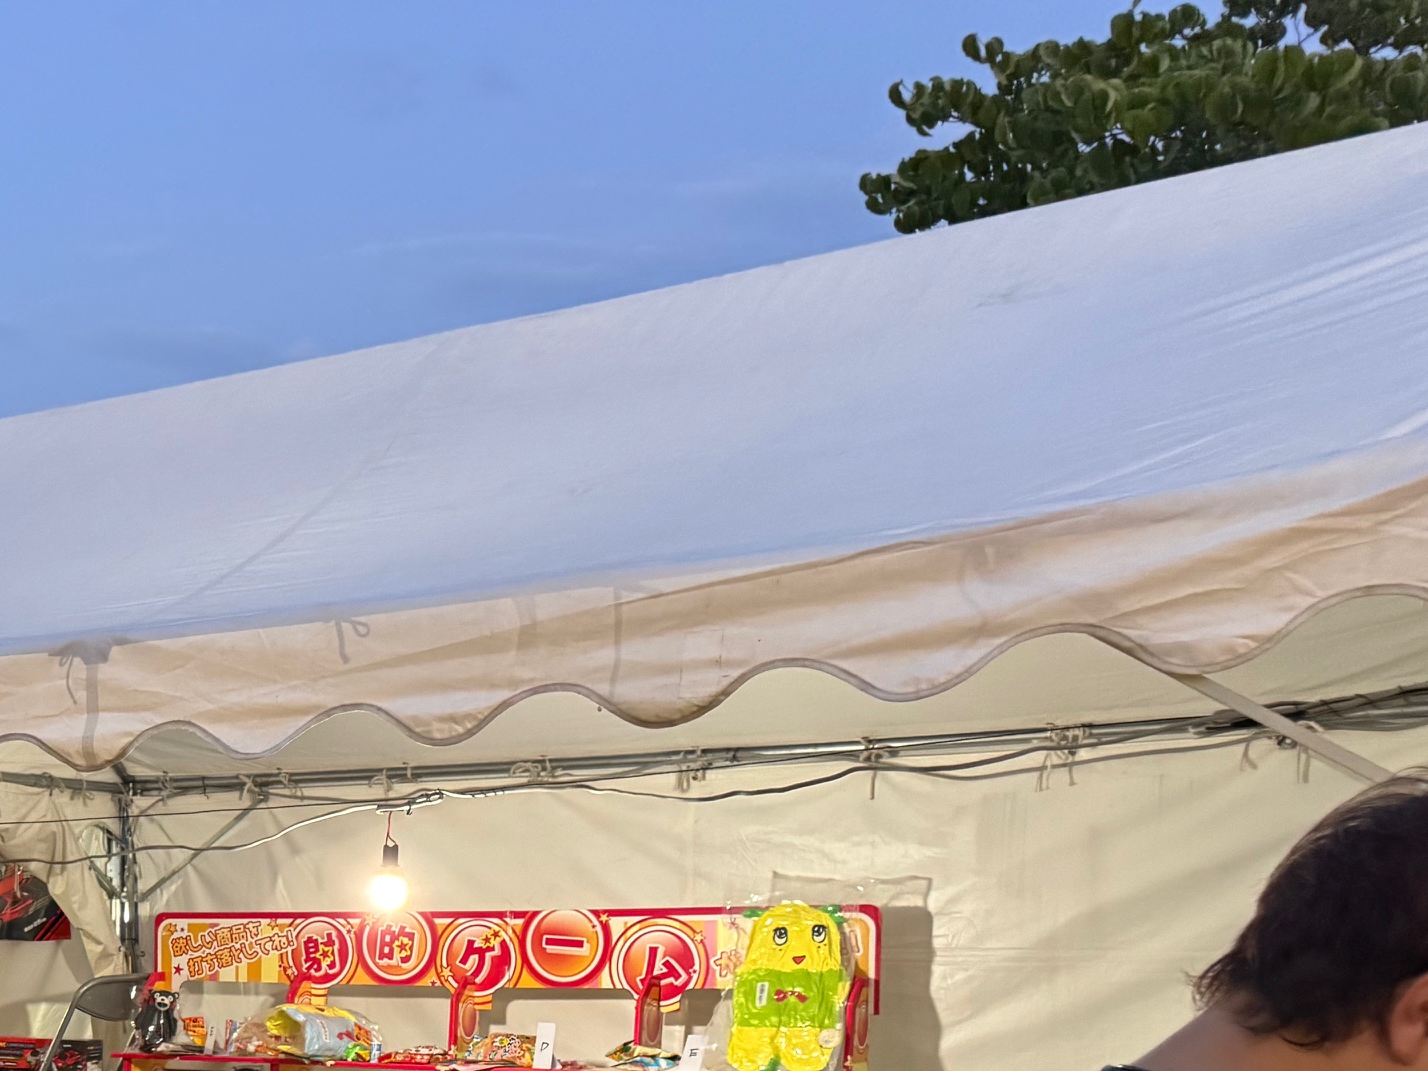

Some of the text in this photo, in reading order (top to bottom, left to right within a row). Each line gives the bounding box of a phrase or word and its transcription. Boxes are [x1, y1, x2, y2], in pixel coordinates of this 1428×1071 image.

[170, 920, 262, 957] 欲しい商品を
[186, 929, 297, 978] 打ち落としてね!
[302, 924, 689, 989] 射的ゲーム
[540, 1041, 550, 1052] D
